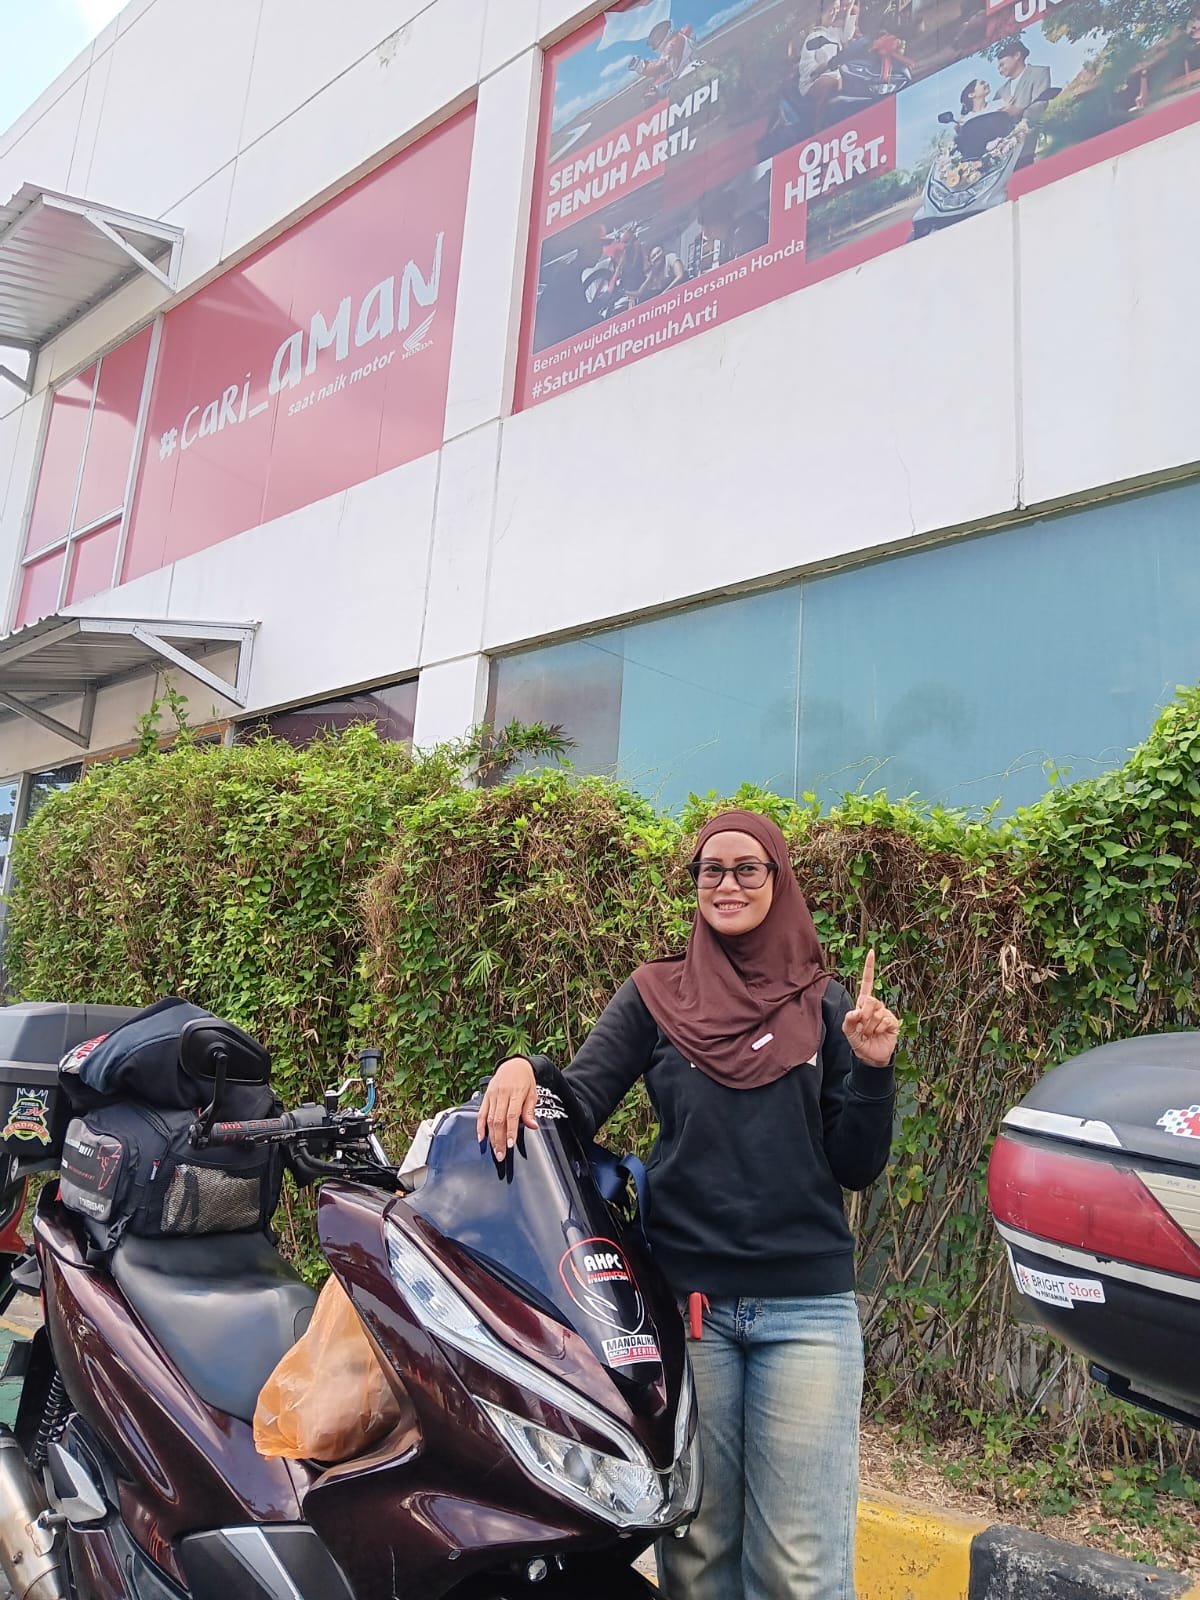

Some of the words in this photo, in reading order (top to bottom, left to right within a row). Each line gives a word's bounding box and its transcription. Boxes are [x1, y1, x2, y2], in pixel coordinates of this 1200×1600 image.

[549, 133, 631, 196] SEMUA
[636, 79, 719, 148] MIMPI
[784, 135, 888, 211] HEART.
[799, 129, 857, 174] One
[545, 163, 628, 225] PENUH
[631, 129, 696, 179] ARTI,
[533, 347, 571, 373] Berani
[573, 318, 635, 354] wujudkan
[638, 295, 682, 323] mimpi
[683, 268, 747, 302] bersama
[751, 239, 804, 273] Honda
[287, 391, 317, 417] saat
[317, 372, 348, 402] naik
[350, 350, 396, 384] motor
[531, 301, 719, 399] #SatuHATIPenuhArti
[583, 1253, 623, 1272] AHPC
[1031, 1274, 1065, 1294] BRIGHT
[1068, 1282, 1101, 1298] Store
